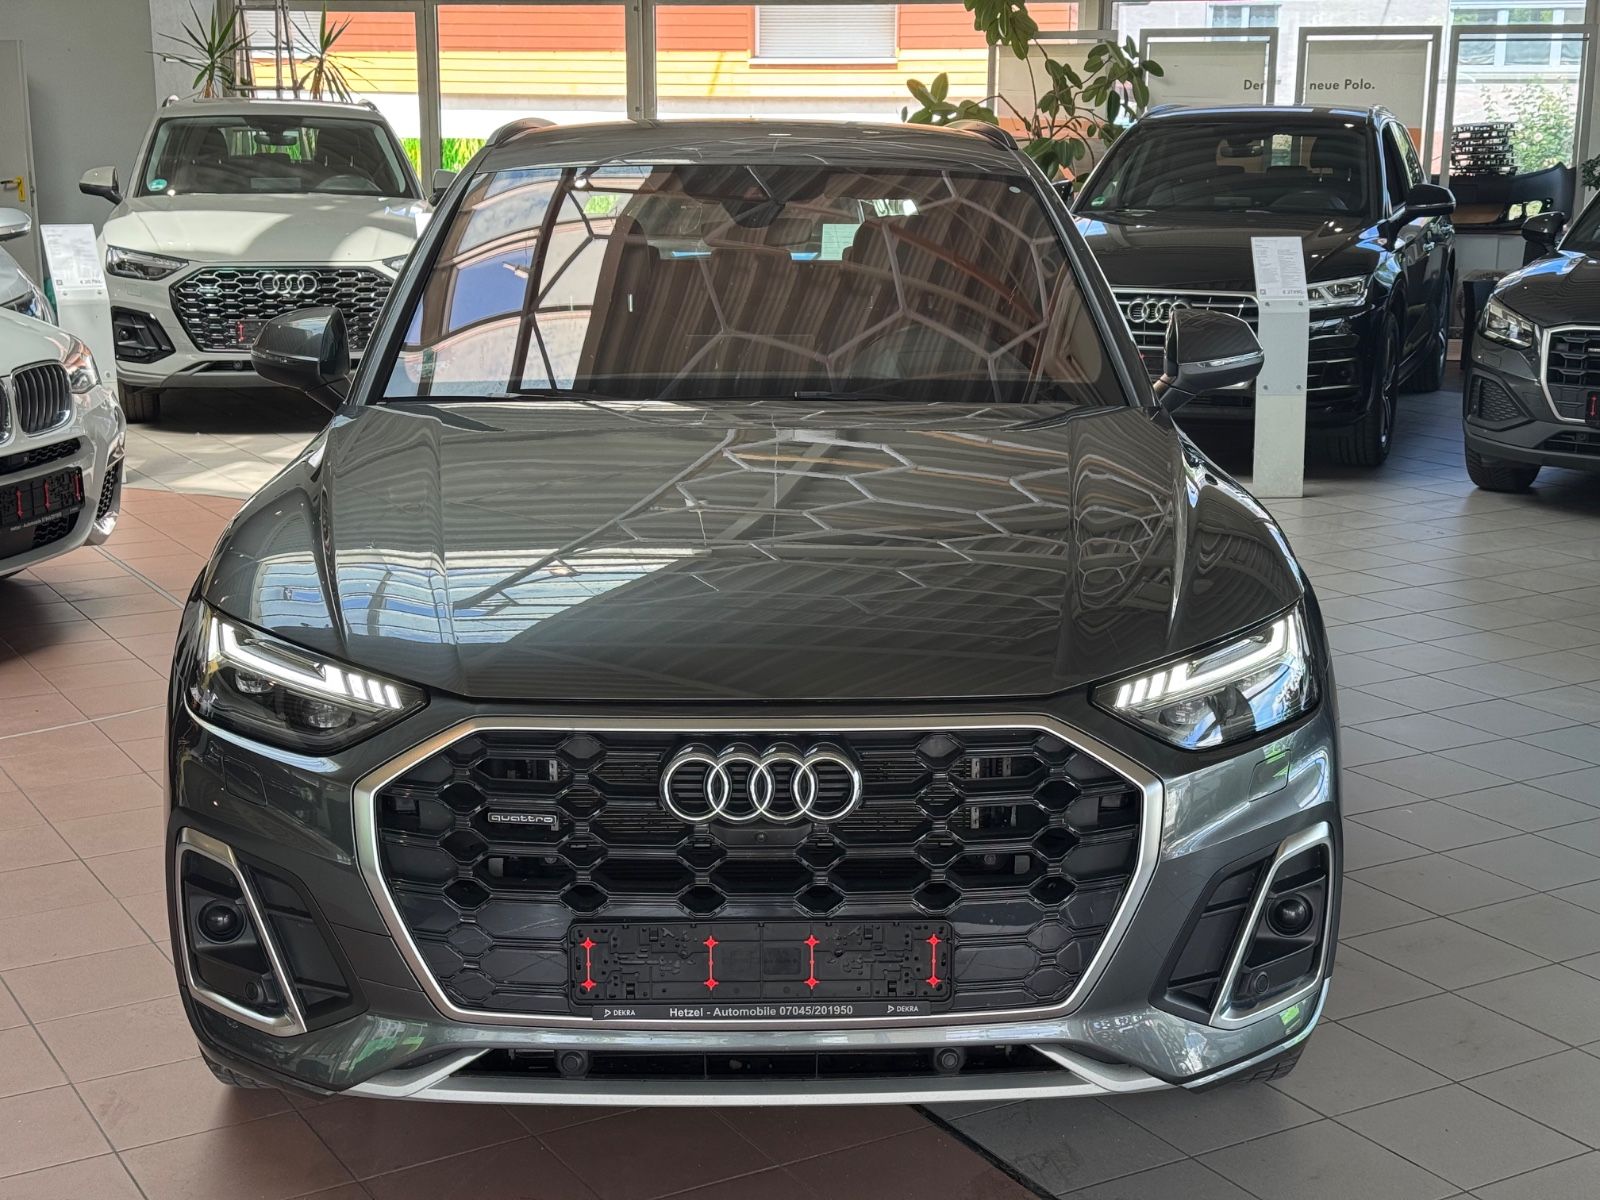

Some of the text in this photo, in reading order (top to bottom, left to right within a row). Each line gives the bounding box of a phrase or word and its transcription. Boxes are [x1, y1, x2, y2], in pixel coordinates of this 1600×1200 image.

[1309, 81, 1340, 90] neue
[1344, 78, 1376, 90] Polo.
[491, 814, 553, 823] quattro
[669, 1007, 703, 1017] Hetzel
[713, 1005, 776, 1017] Automobile
[779, 1005, 853, 1016] 07045/201950
